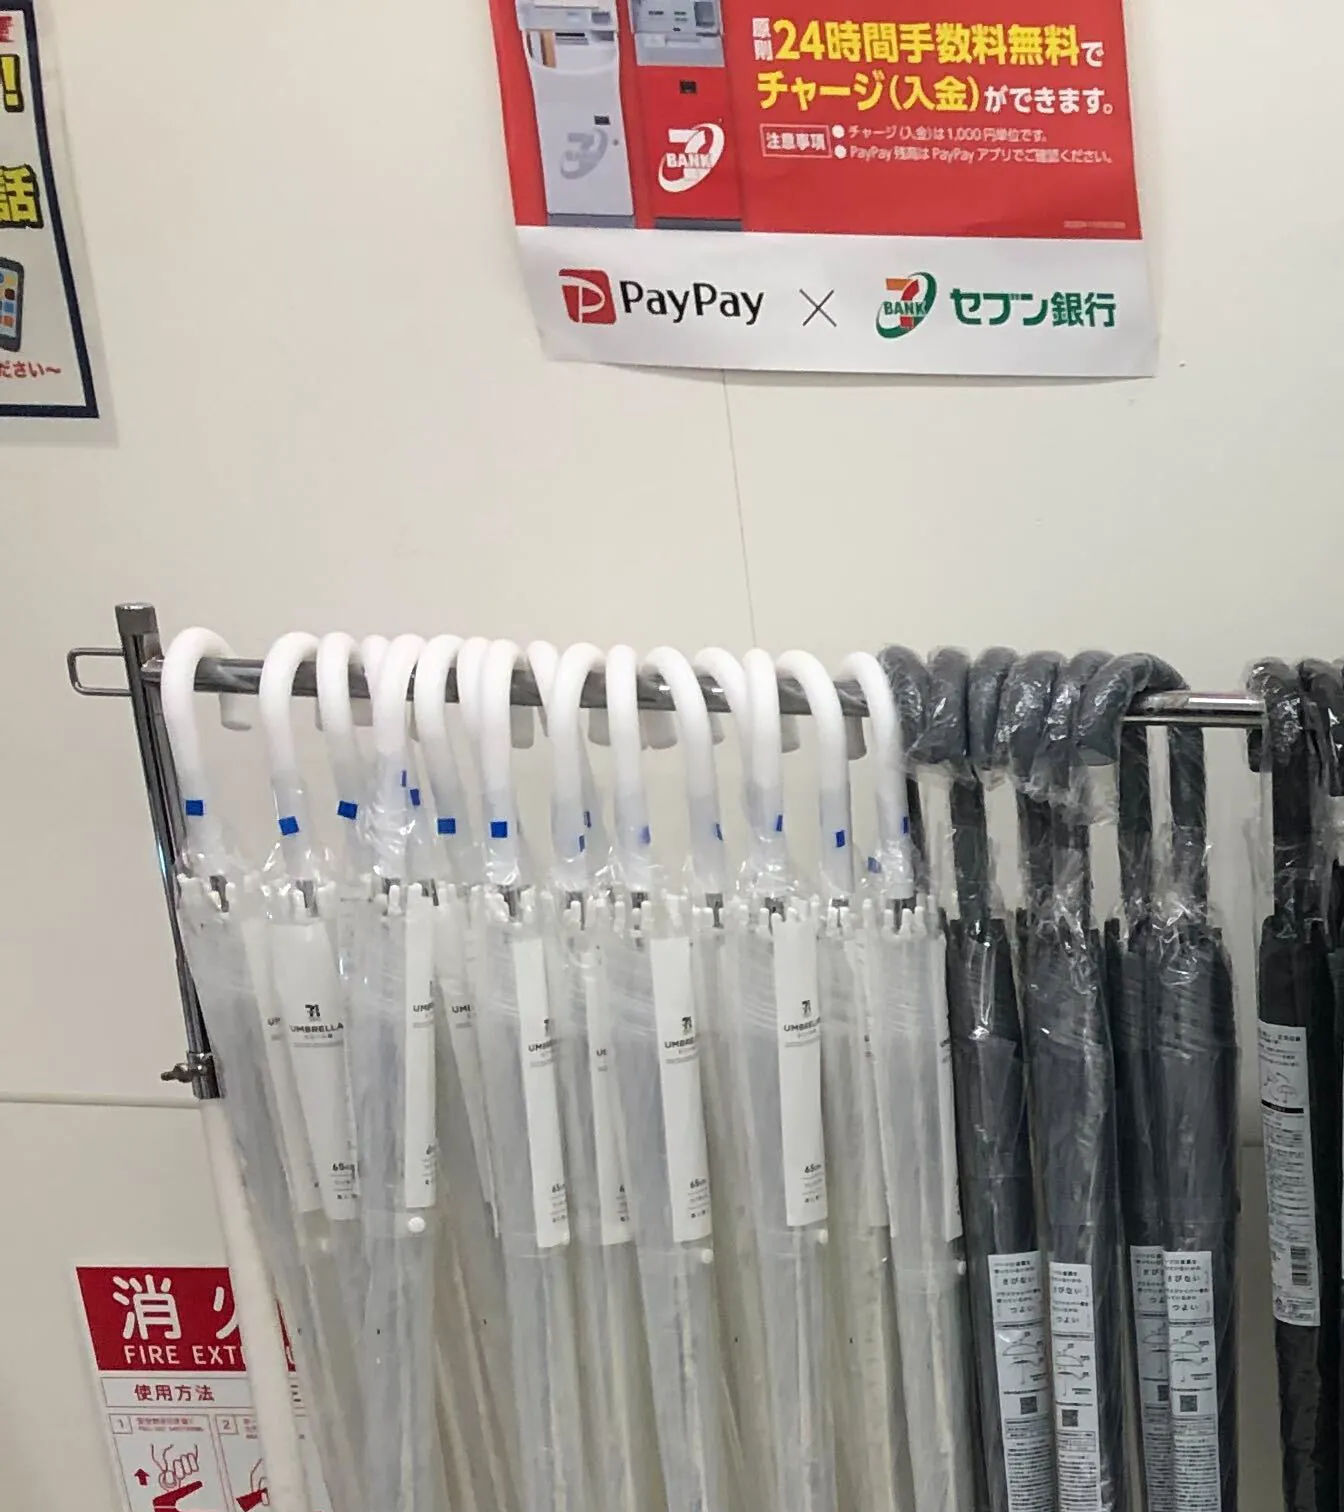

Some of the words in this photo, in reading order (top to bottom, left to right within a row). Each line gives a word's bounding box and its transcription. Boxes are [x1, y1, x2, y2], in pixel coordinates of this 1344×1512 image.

[773, 19, 1104, 67] 24時間手数料無料で
[620, 280, 764, 325] PayPay
[883, 301, 926, 317] BANK
[950, 288, 1117, 328] セブン銀行
[123, 1345, 180, 1364] FIRE
[134, 1383, 215, 1402] 使用方法
